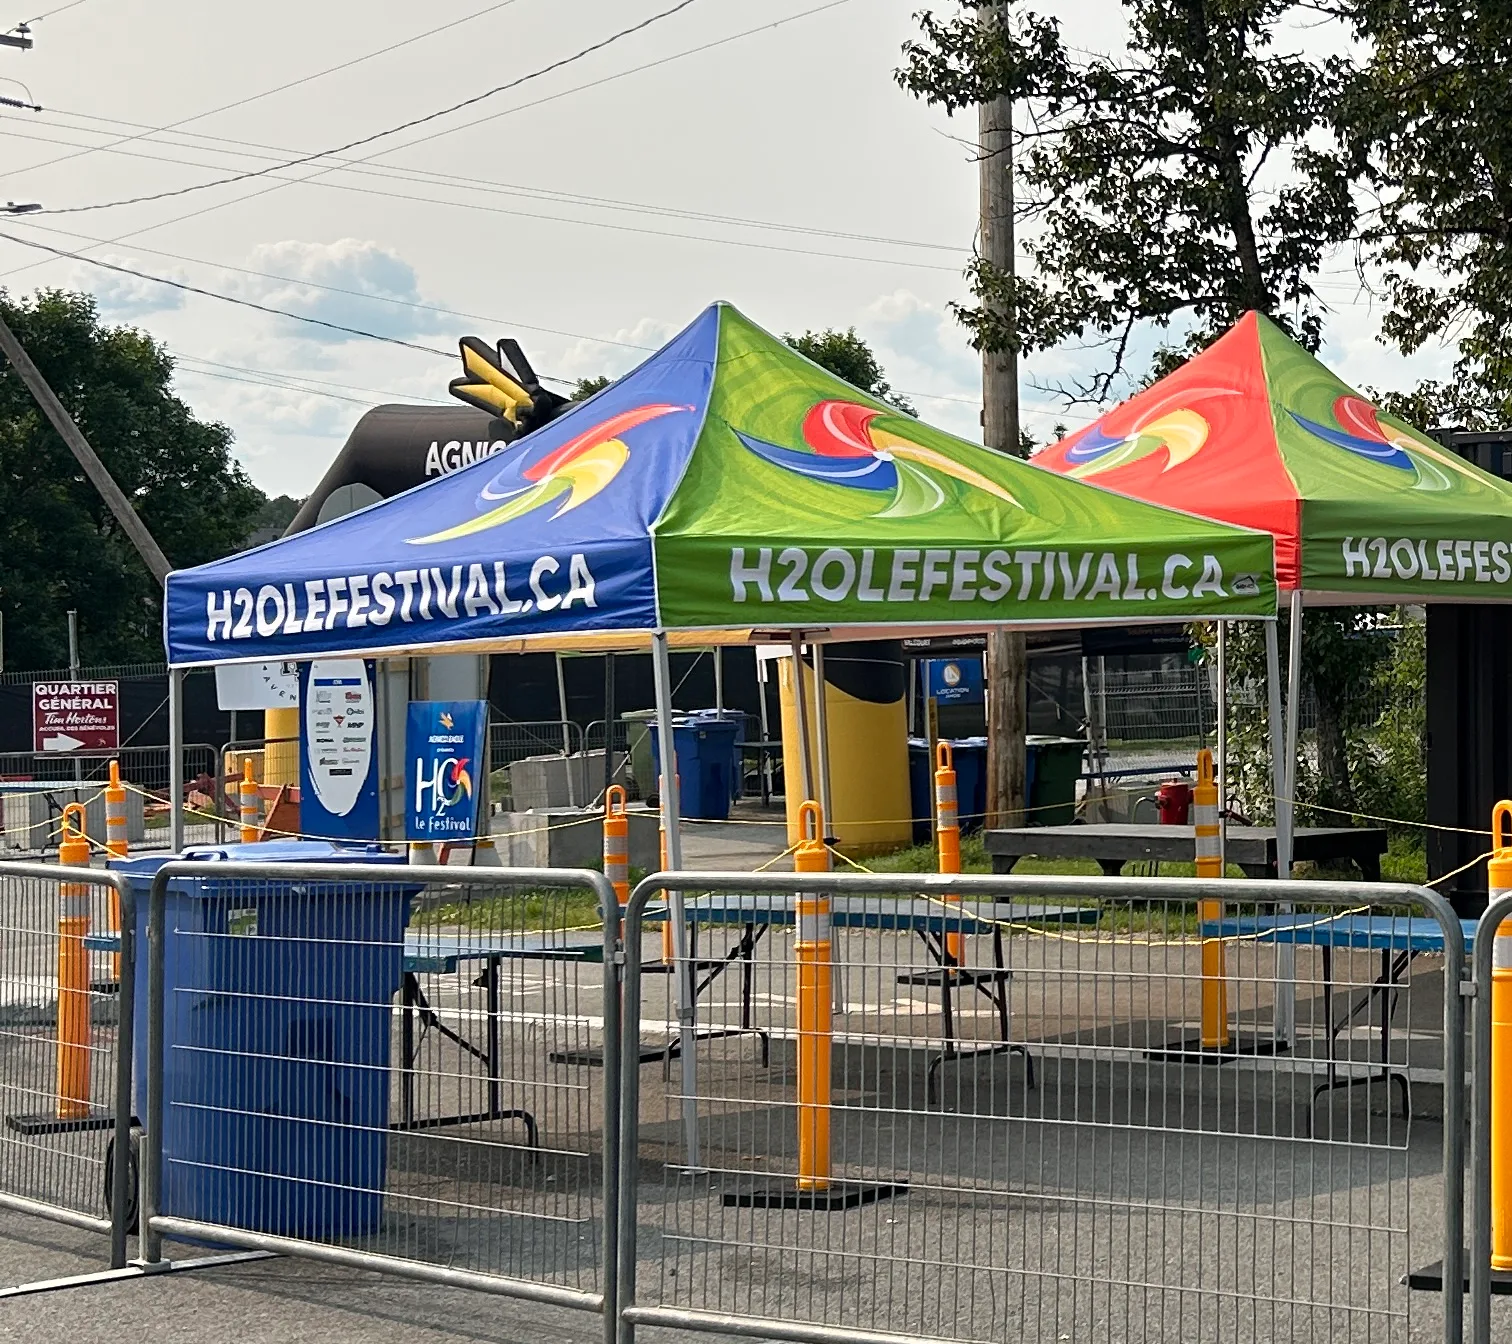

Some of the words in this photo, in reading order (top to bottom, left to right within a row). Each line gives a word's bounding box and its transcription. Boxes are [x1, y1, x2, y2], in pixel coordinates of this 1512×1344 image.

[425, 440, 519, 476] AGNI
[730, 547, 1229, 602] H2OLEFESTIVAL.CA
[207, 553, 598, 642] H2OLEFESTIVAL.CA
[35, 683, 116, 695] QUARTIER
[38, 696, 114, 710] GÉNÉRAL
[44, 712, 65, 724] Tim
[65, 711, 107, 724] Hortons
[415, 816, 426, 830] le
[428, 816, 471, 833] festival
